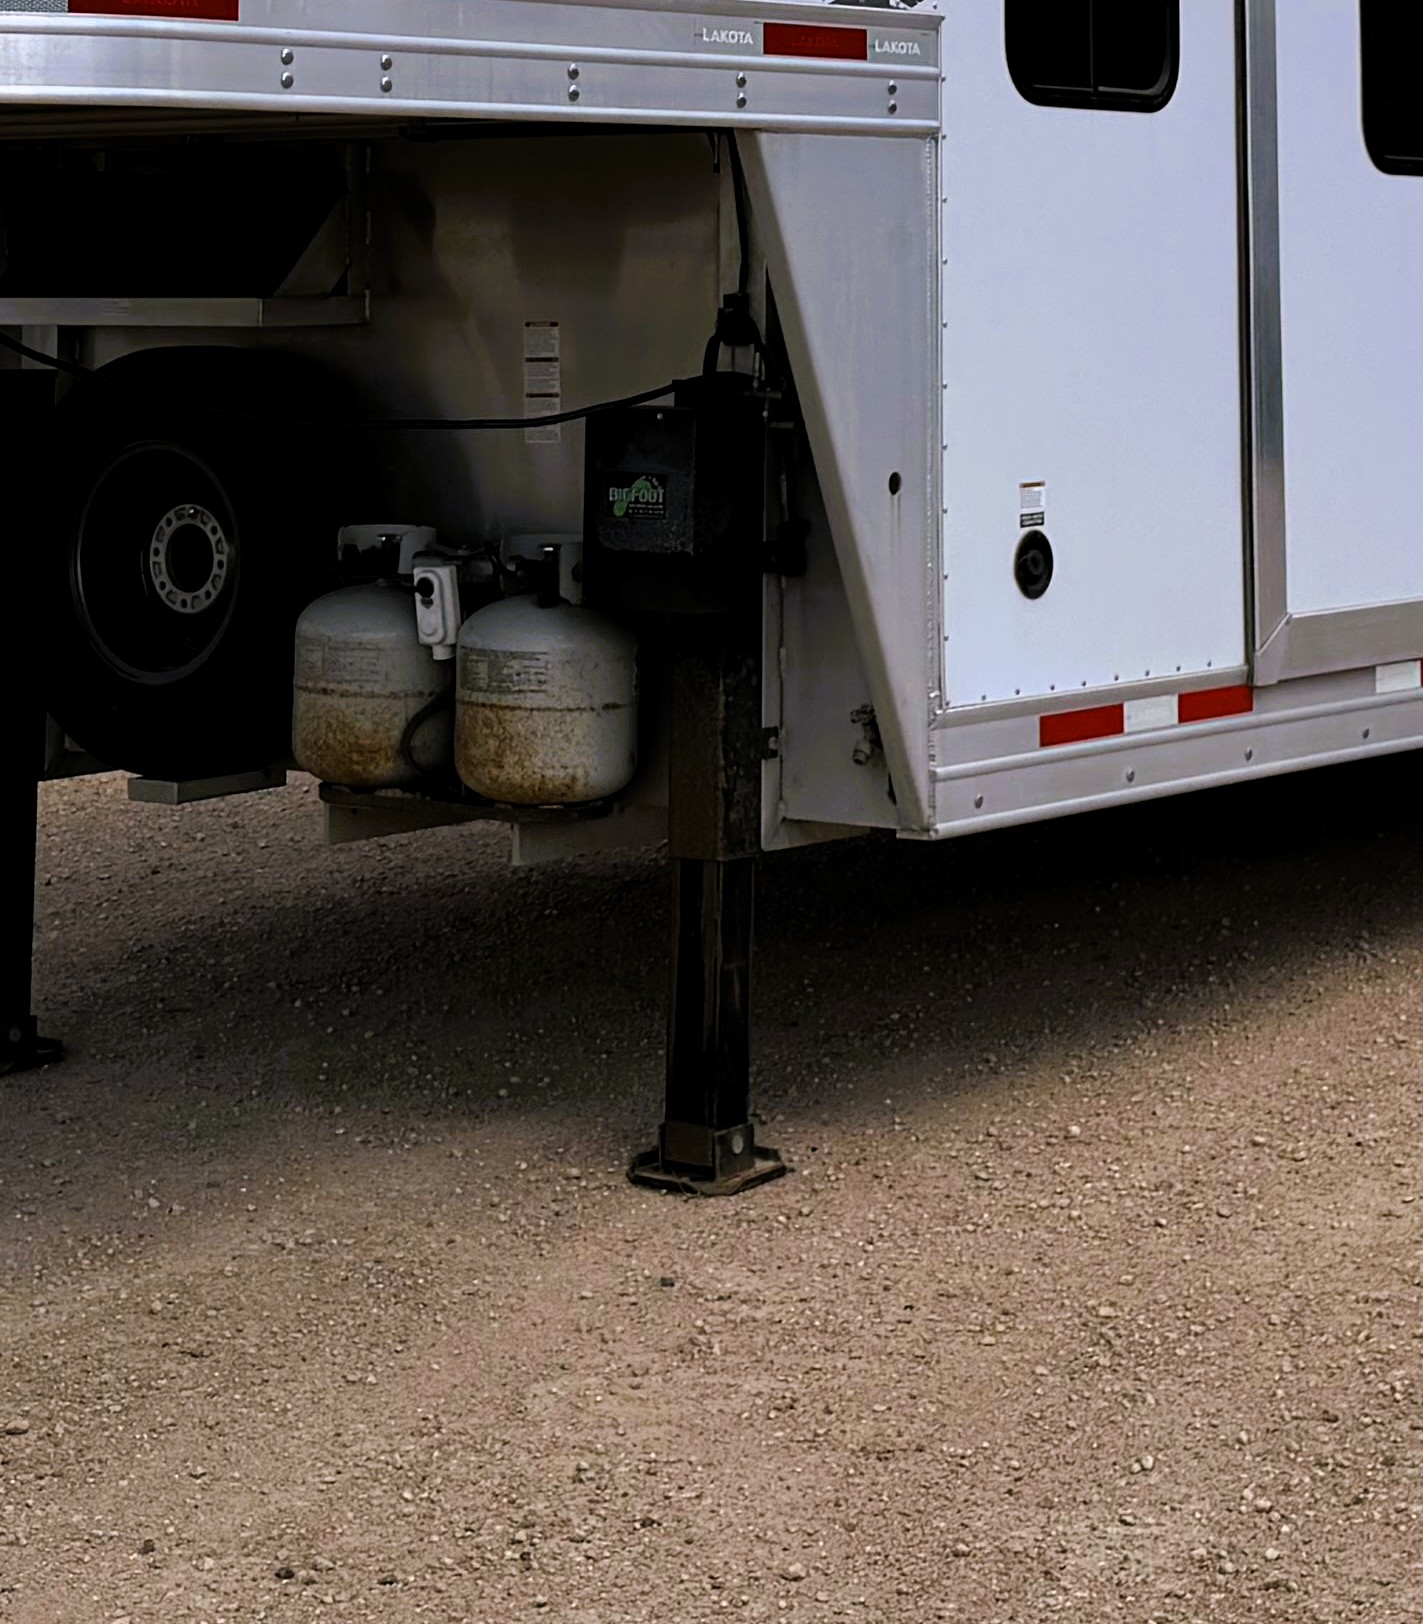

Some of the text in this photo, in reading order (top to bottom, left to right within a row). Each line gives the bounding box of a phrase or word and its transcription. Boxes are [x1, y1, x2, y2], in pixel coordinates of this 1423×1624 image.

[702, 28, 754, 45] LAKOTA
[875, 39, 921, 56] LAKOTA
[608, 487, 665, 504] BIGFOOT
